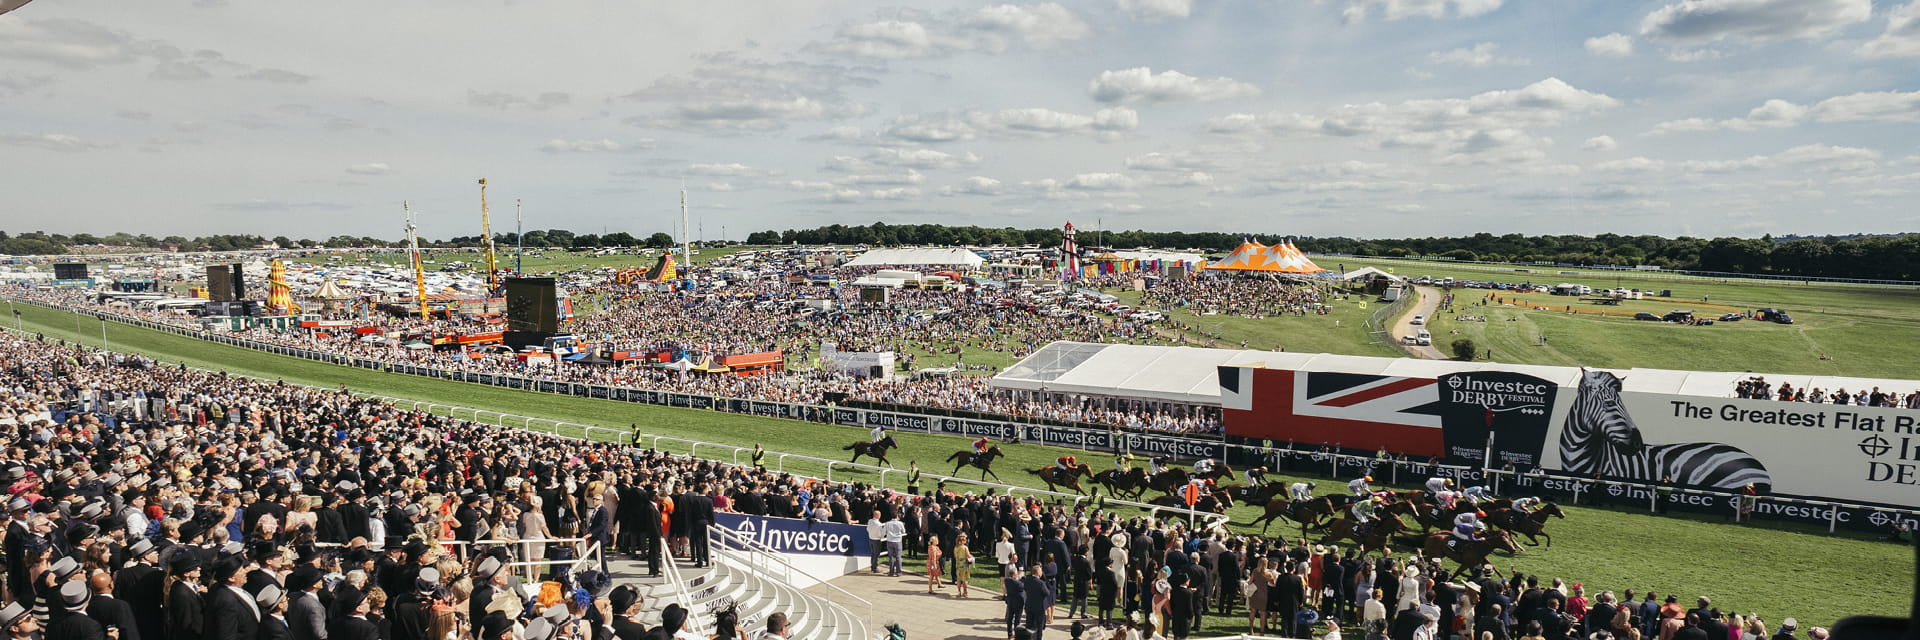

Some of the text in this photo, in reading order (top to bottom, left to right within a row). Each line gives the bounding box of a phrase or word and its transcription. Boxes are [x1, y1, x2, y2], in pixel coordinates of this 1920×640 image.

[1466, 376, 1547, 395] Investec
[1452, 390, 1546, 407] DERBY FESTIVAL
[751, 403, 788, 415] nvestec
[1670, 400, 1713, 420] The
[1720, 404, 1826, 428] Greatest
[1834, 411, 1885, 432] Flat
[880, 412, 928, 429] Investec
[958, 420, 1011, 437] Investec
[1144, 438, 1214, 457] Investec
[1458, 446, 1484, 454] Investec
[1506, 450, 1533, 459] Investec
[1411, 463, 1480, 480] Inestec
[1865, 461, 1920, 485] DE
[1517, 474, 1591, 494] Inestec
[1627, 485, 1713, 506] Invstec
[1751, 498, 1851, 522] Investec
[758, 519, 851, 553] Investec
